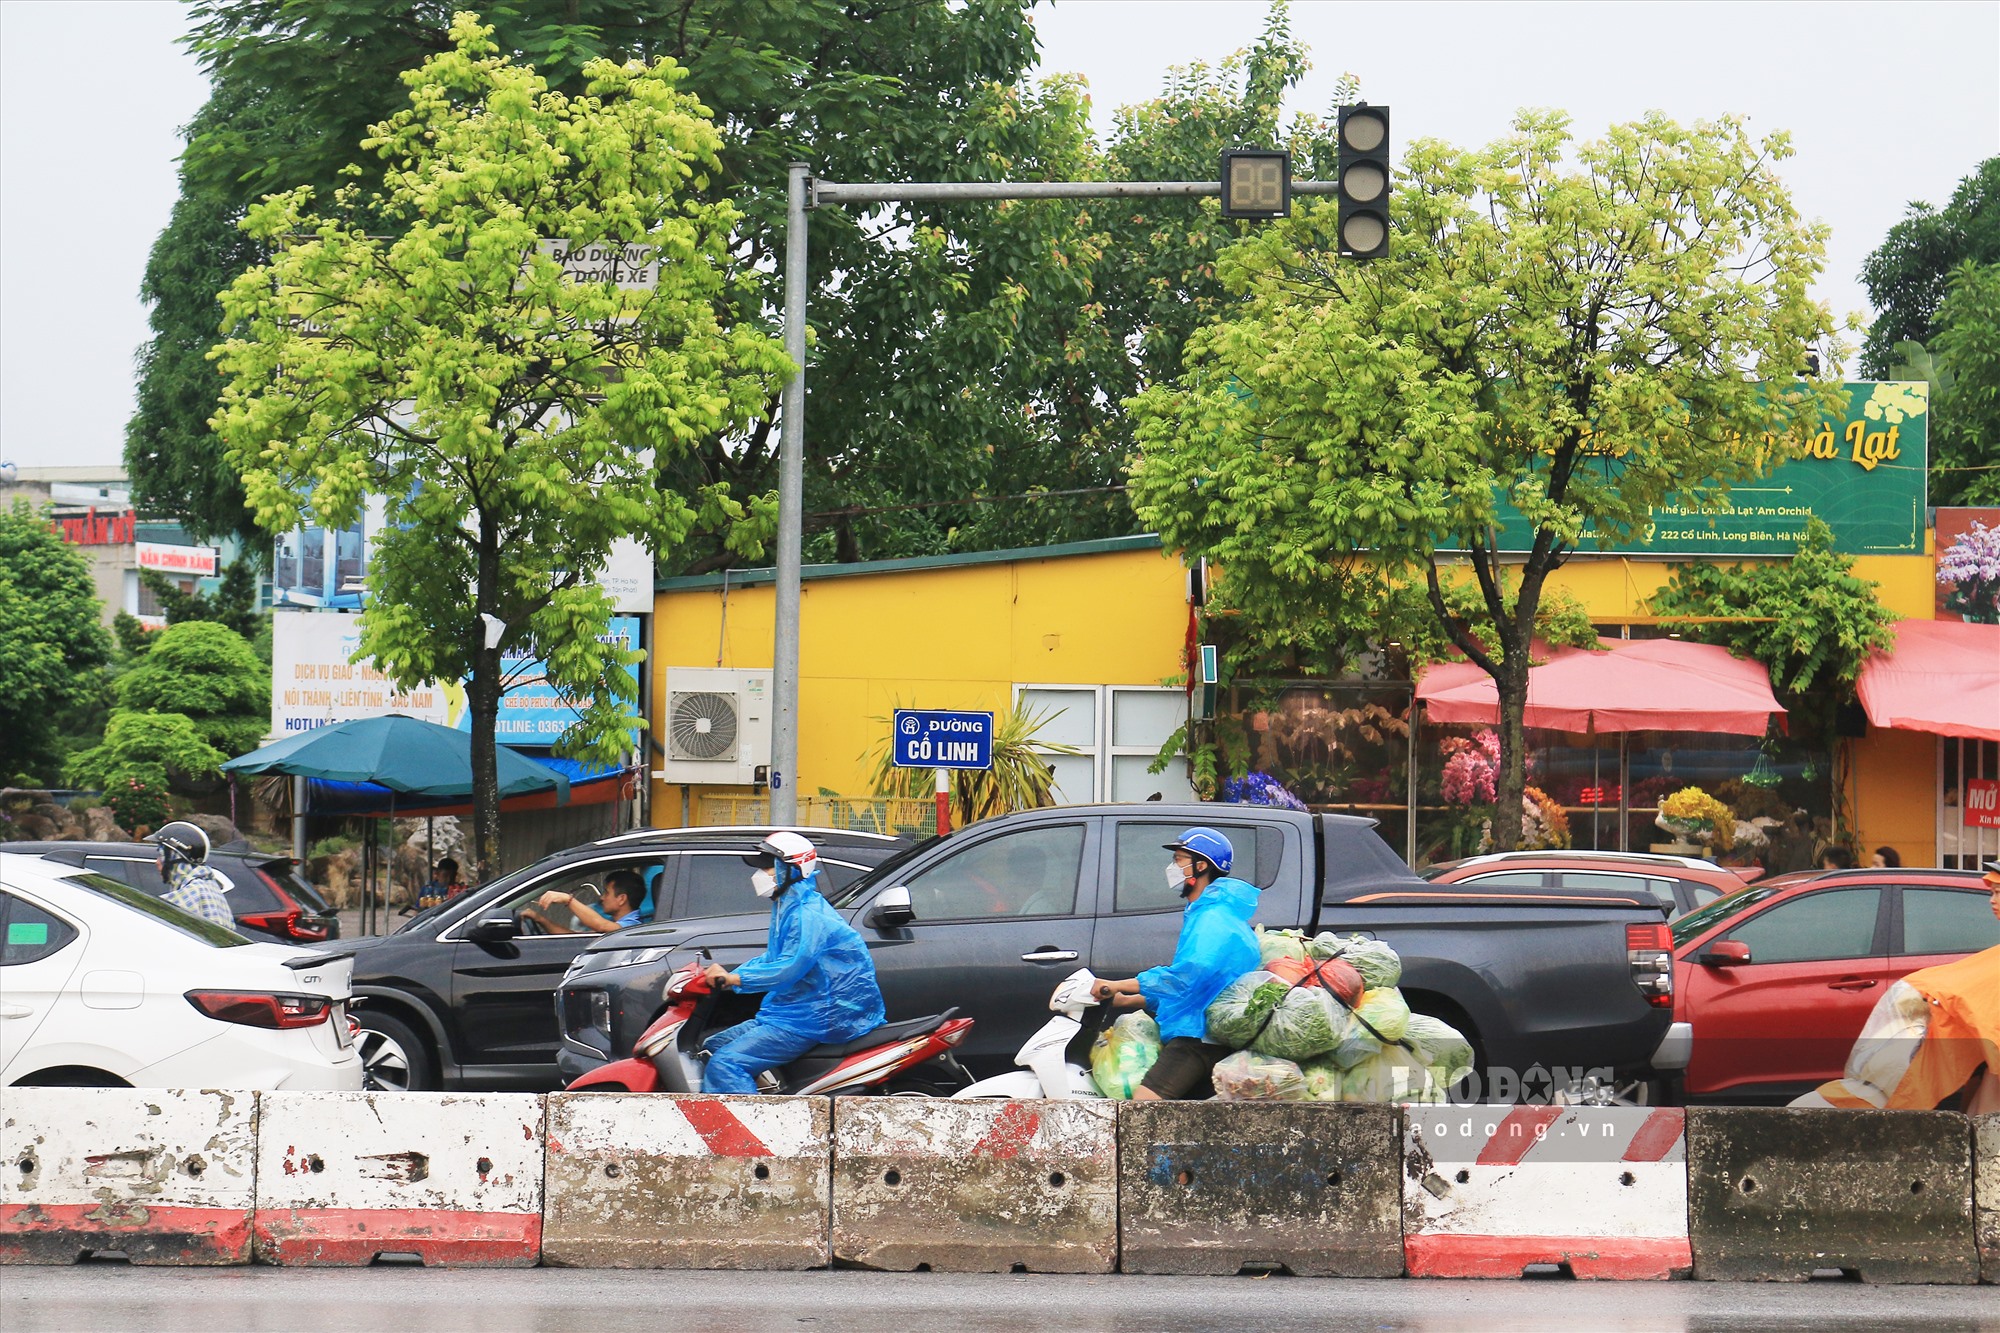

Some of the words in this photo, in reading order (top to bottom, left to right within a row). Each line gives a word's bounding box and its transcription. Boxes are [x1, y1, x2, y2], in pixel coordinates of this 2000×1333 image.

[627, 270, 648, 282] XE
[1845, 420, 1901, 471] Lạt
[1737, 506, 1754, 517] Lạt
[1777, 506, 1812, 516] Orchid
[1661, 530, 1679, 540] 222
[1696, 530, 1721, 541] Linh,
[1722, 530, 1748, 542] Long
[1750, 531, 1775, 541] Biên,
[1776, 531, 1791, 541] Hà
[295, 663, 316, 682] DỊCH
[318, 664, 330, 683] VỤ
[332, 665, 353, 680] GIAO
[284, 687, 300, 709] NỘI
[411, 692, 433, 709] NAM
[928, 718, 983, 733] ĐƯỜNG
[908, 731, 932, 760] CỔ
[937, 741, 978, 762] LINH
[1968, 783, 1998, 811] MỞ
[1980, 815, 1992, 824] Xin
[303, 975, 323, 984] CITY
[1071, 1089, 1099, 1097] HONDA
